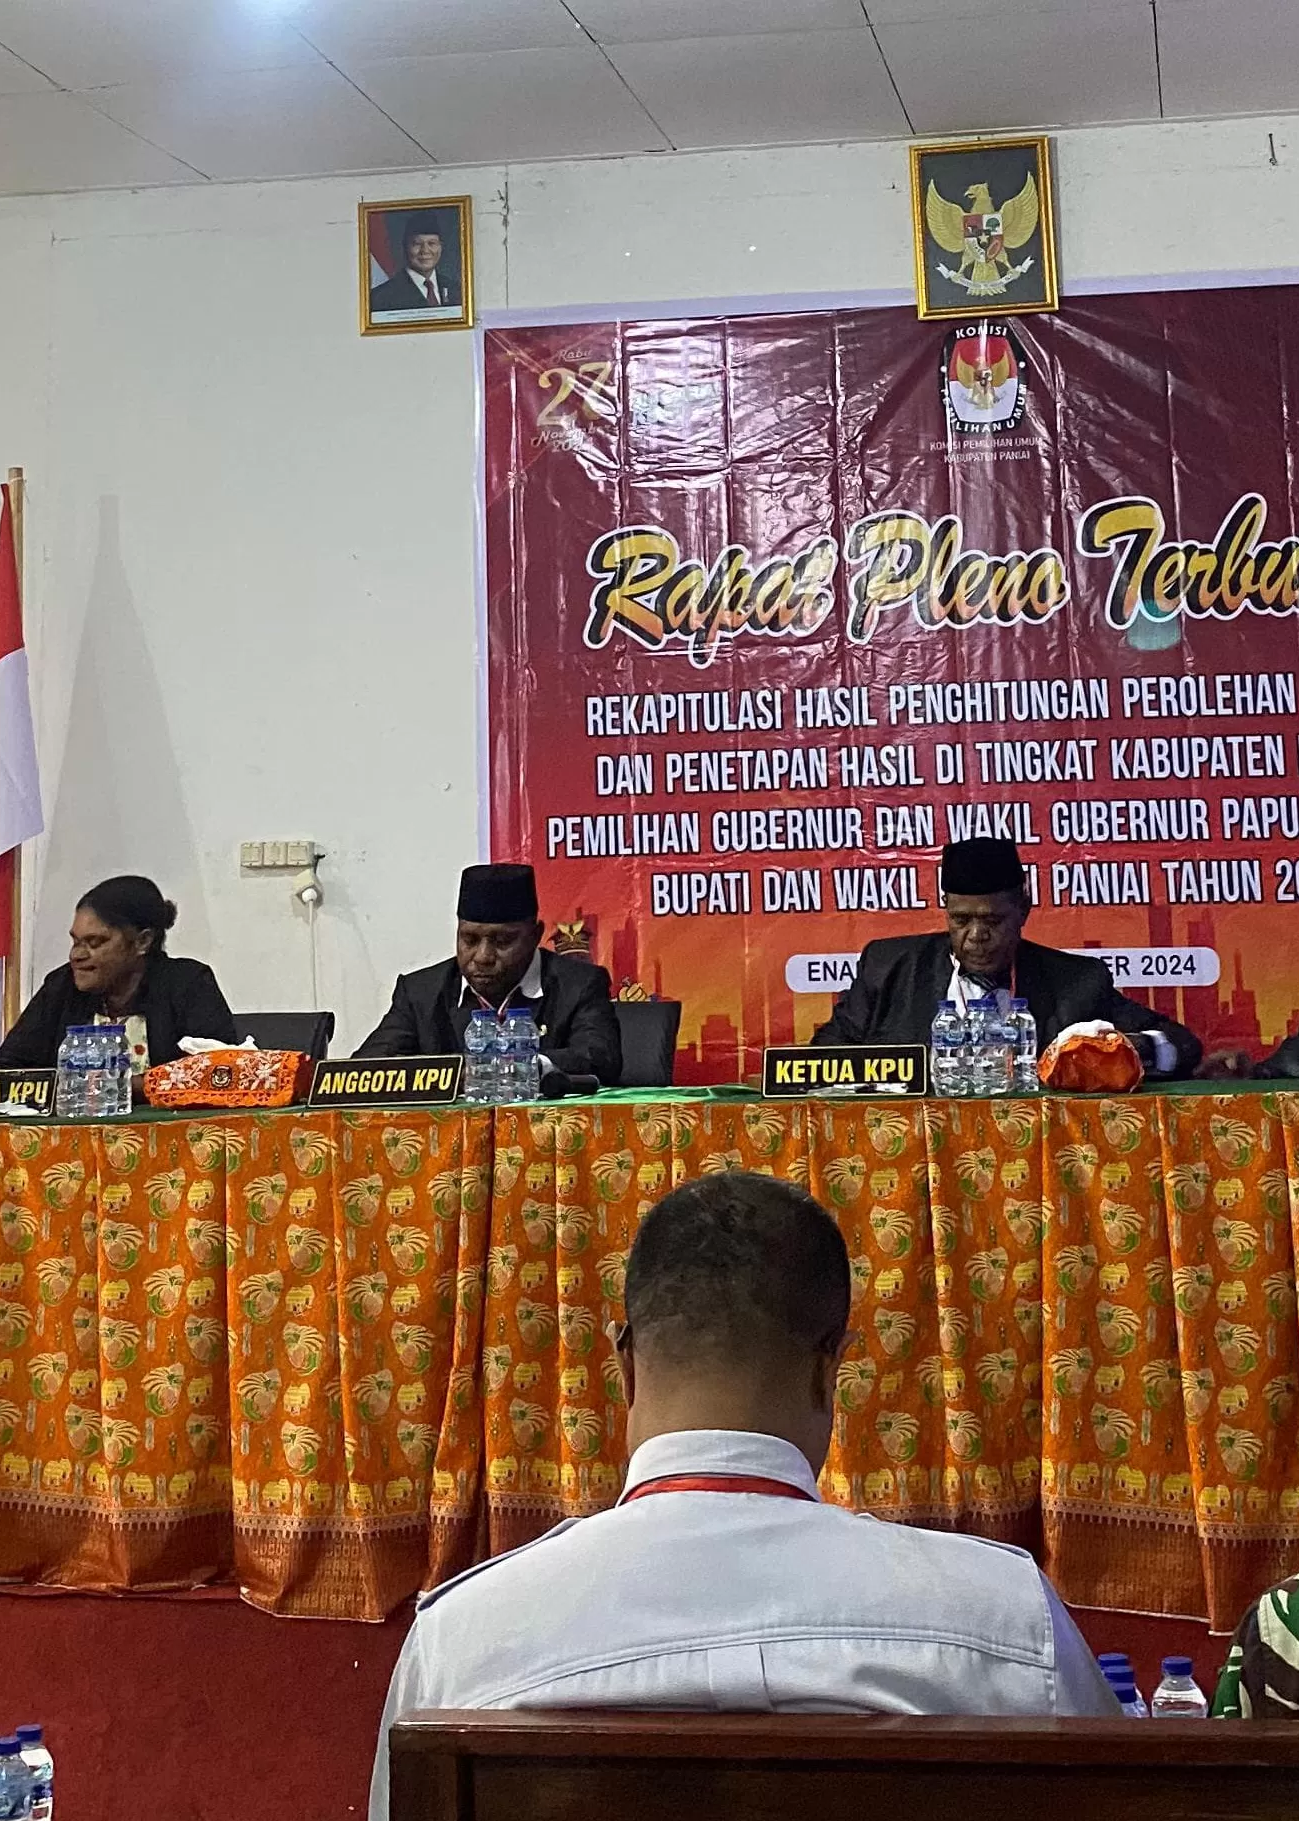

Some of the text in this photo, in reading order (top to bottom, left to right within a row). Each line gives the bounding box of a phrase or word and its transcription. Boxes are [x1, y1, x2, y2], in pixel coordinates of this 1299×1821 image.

[955, 325, 1008, 339] KOMISI
[536, 361, 612, 427] 27
[1006, 384, 1027, 429] UMUM
[963, 438, 1013, 450] PEMILIHAN
[1014, 436, 1043, 447] UMUM
[1000, 450, 1031, 461] PANIAI
[584, 525, 837, 668] Rapat
[846, 509, 1069, 645] Pleno
[586, 690, 782, 736] REKAPITULASI
[796, 687, 878, 730] HASIL
[889, 678, 1109, 726] PENGHITUNGAN
[1122, 673, 1296, 718] PEROLEHAN
[596, 754, 654, 796] DAN
[665, 747, 829, 793] PENETAPAN
[840, 745, 924, 787] HASIL
[936, 743, 964, 784] DI
[975, 739, 1097, 783] TINGKAT
[1110, 734, 1285, 780] KABUPATEN
[547, 811, 699, 858] PEMILIHAN
[712, 807, 863, 852] GUBERNUR
[876, 804, 933, 847] DAN
[945, 801, 1040, 844] WAKIL
[1051, 798, 1209, 843] GUBERNUR
[652, 871, 751, 917] BUPATI
[763, 868, 821, 913] DAN
[833, 866, 926, 911] WAKIL
[1052, 861, 1150, 906] PANIAI
[1161, 859, 1262, 904] TAHUN
[1141, 954, 1196, 976] 2024
[318, 1067, 453, 1095] ANGGOTA KPU
[775, 1056, 915, 1084] KETUA KPU
[8, 1079, 50, 1105] KPU
